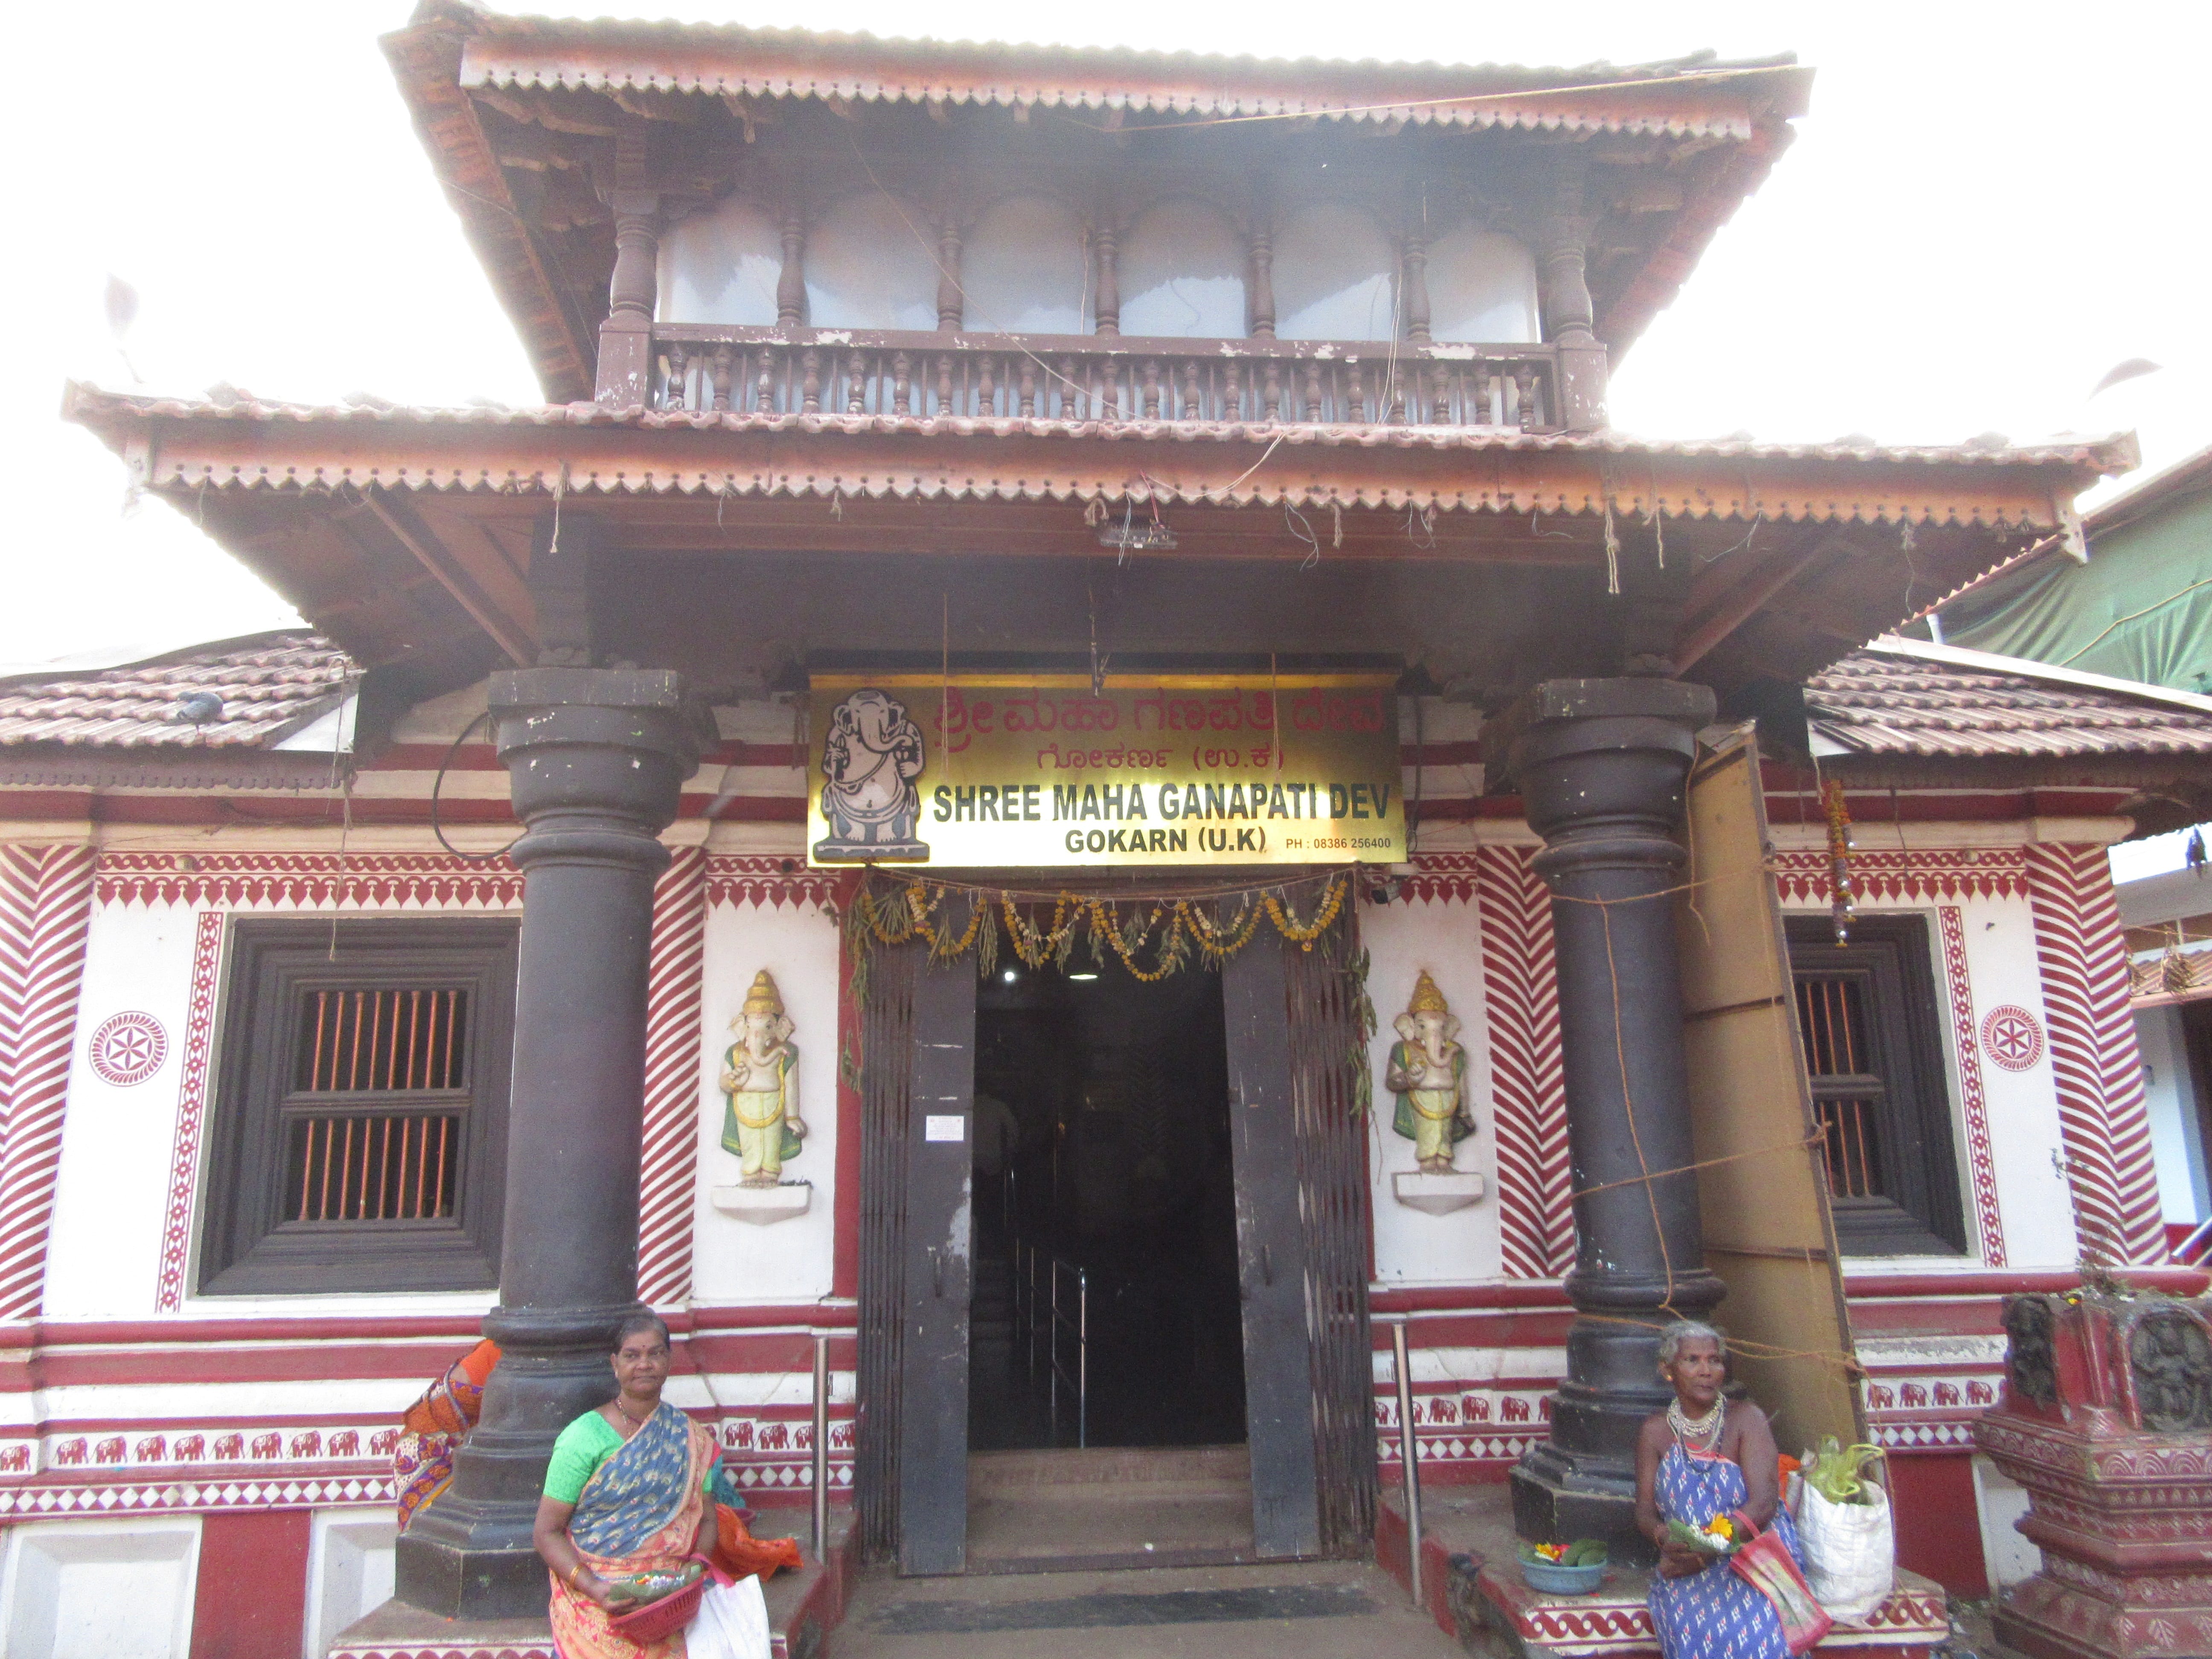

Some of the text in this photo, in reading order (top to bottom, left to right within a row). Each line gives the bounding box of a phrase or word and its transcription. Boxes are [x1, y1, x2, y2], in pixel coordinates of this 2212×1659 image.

[934, 686, 995, 753] ಶ್ರೀ
[1004, 687, 1120, 732] ಮಹಾ
[1134, 687, 1275, 731] ಗಣಪತಿ
[1038, 743, 1173, 768] ಗೋಕರ್ಣ
[934, 783, 1390, 822] SHREE MAHA GANAPATI DEV
[1065, 827, 1266, 853] GOKARN (U.K)
[1286, 838, 1302, 848] PH
[1314, 838, 1347, 848] 08386
[1351, 838, 1391, 848] 256400
